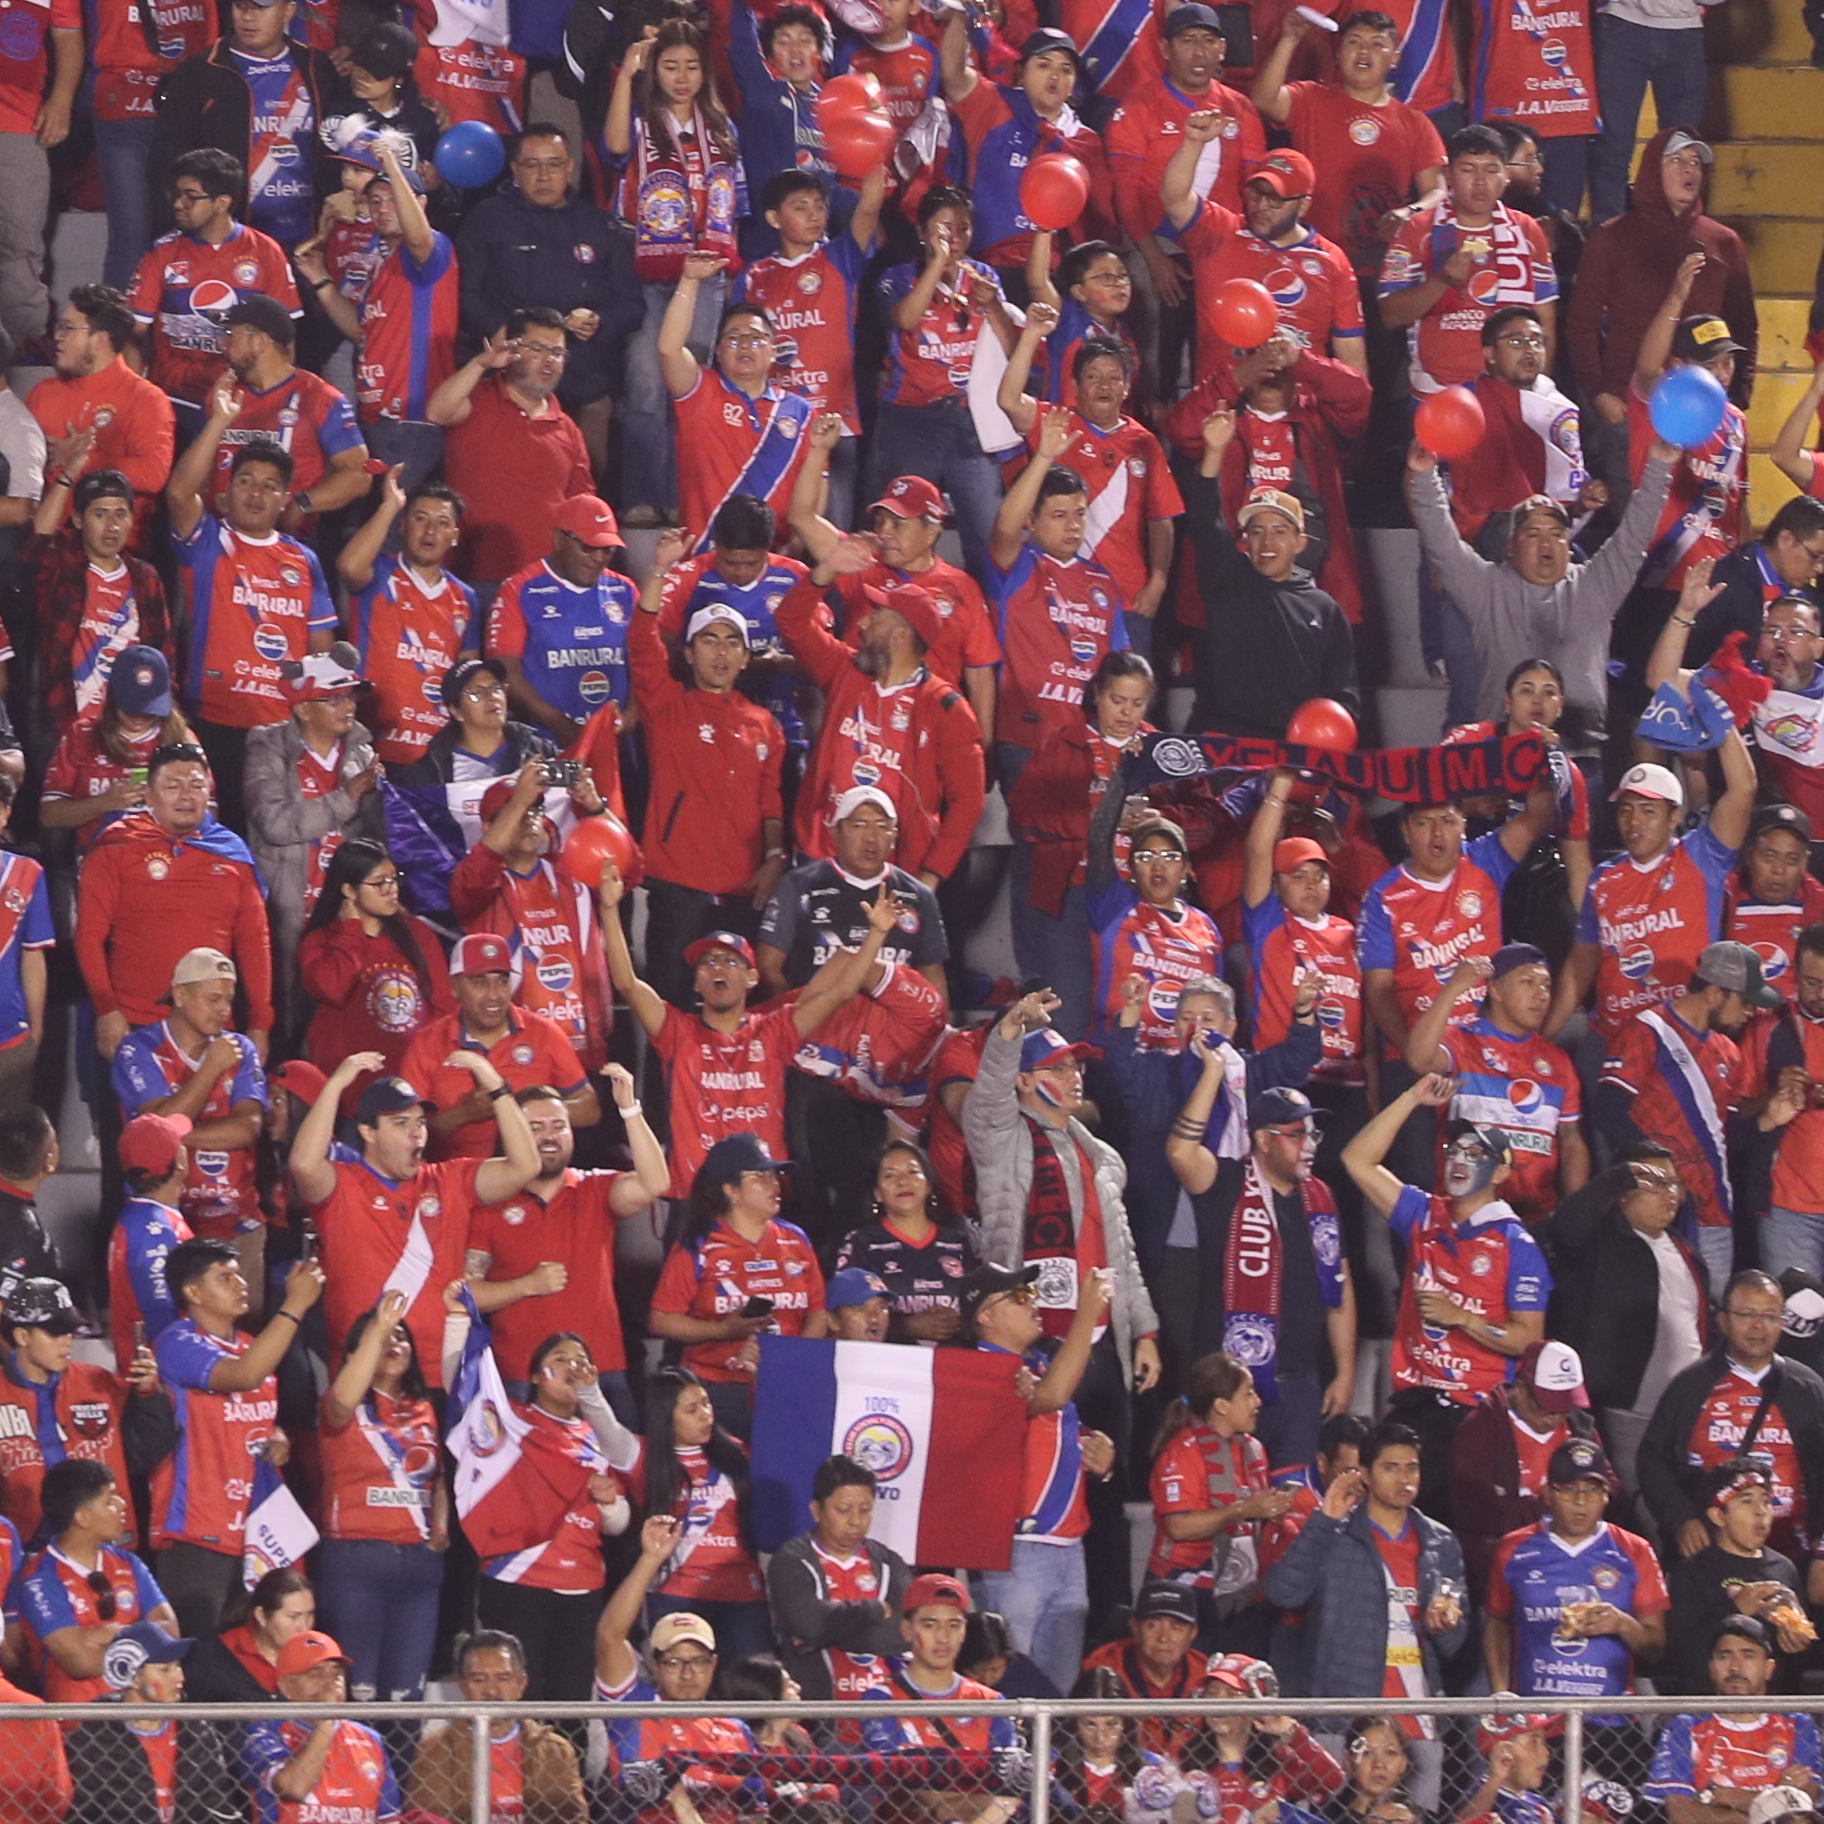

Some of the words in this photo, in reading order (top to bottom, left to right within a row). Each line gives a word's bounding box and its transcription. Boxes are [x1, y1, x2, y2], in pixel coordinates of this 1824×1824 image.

[1511, 11, 1583, 33] BANRURAL
[1539, 76, 1586, 94] elektra
[723, 402, 745, 420] 82
[548, 648, 625, 668] BANRURAL
[538, 967, 573, 981] PEPSI
[1239, 1207, 1272, 1278] CLUB
